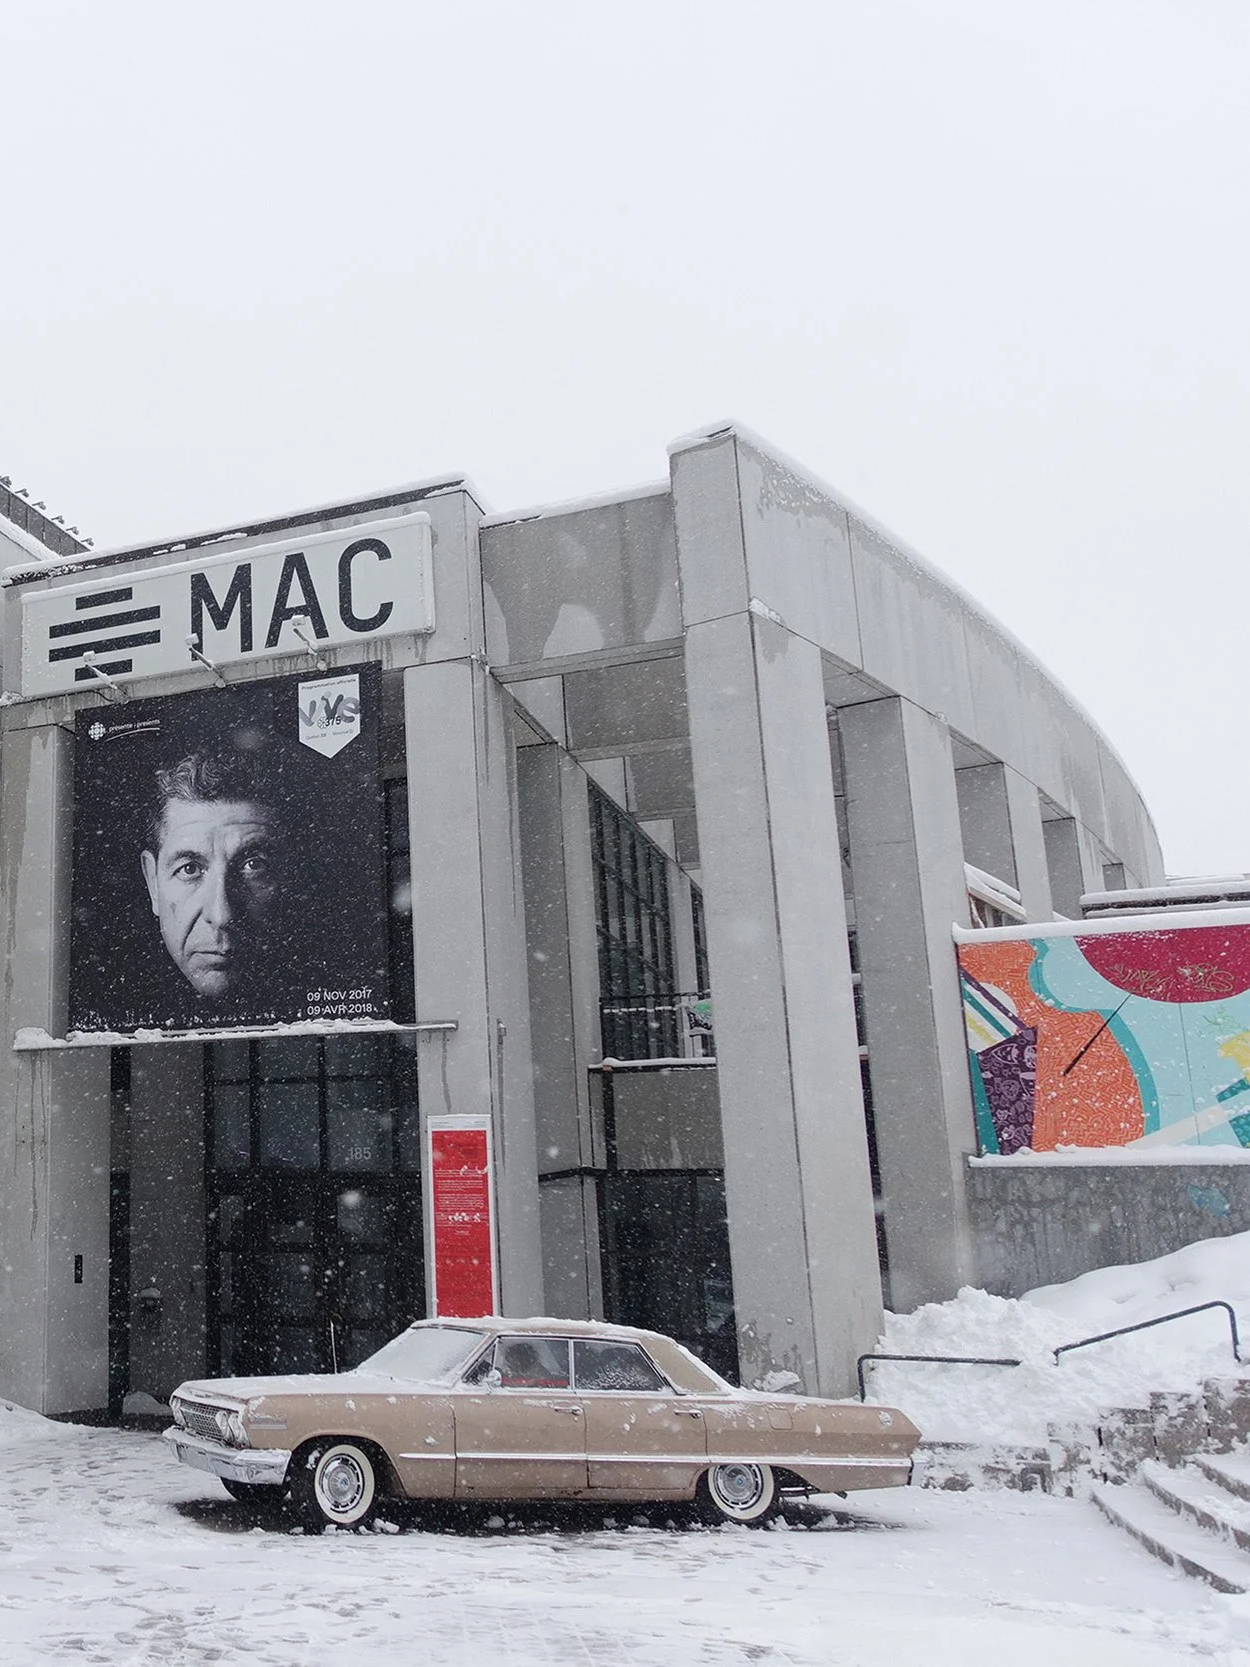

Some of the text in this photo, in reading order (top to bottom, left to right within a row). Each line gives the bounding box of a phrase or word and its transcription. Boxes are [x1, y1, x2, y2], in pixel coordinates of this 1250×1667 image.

[191, 538, 393, 661] MAC
[307, 989, 372, 1001] 09 NOV 2017
[307, 1003, 372, 1015] 09 AVR 2018
